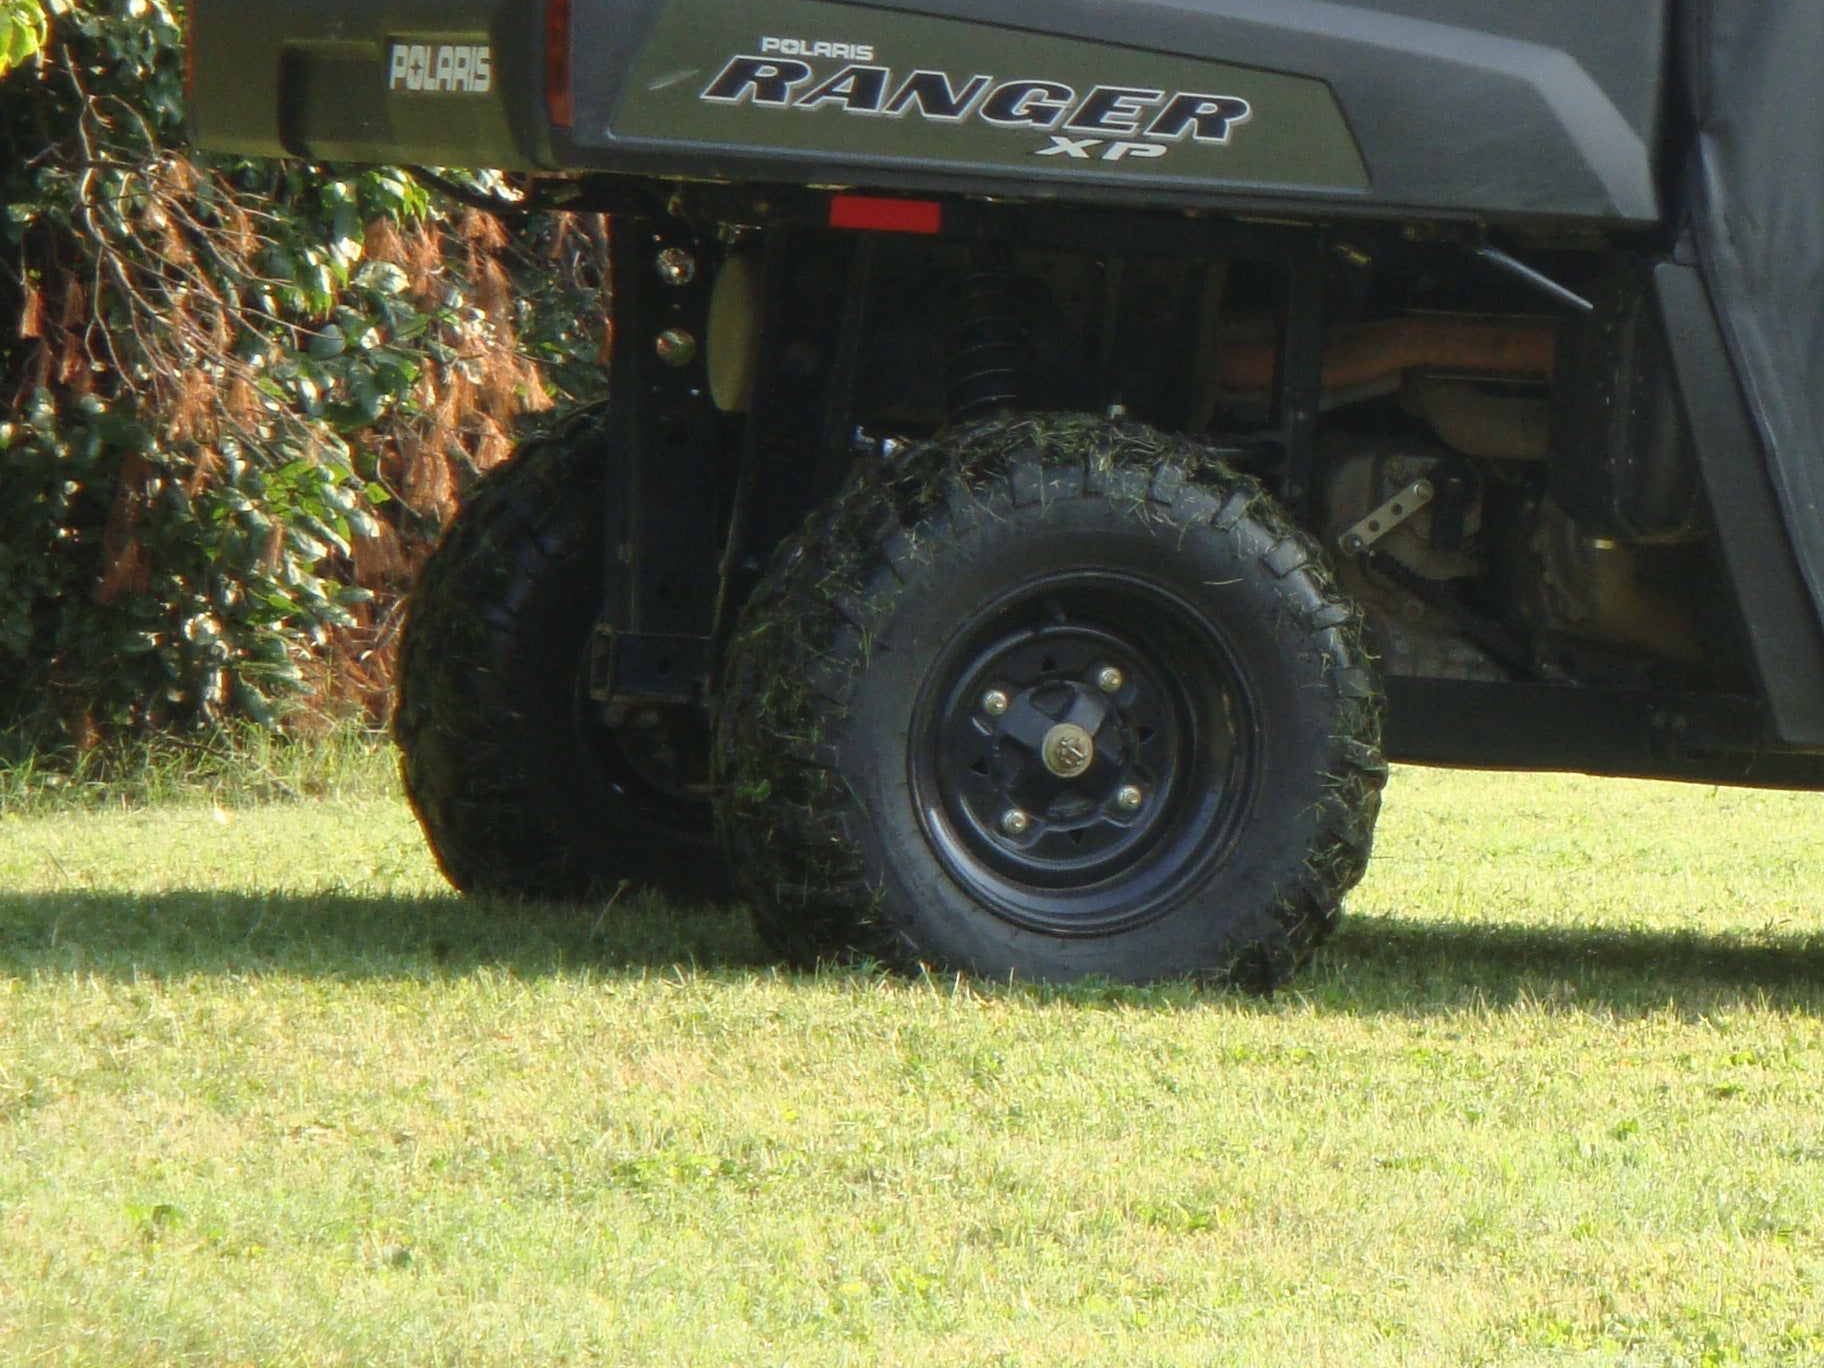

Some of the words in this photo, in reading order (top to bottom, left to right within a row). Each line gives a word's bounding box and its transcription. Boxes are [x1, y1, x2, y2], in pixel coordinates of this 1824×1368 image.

[761, 36, 874, 61] POLARIS
[390, 45, 491, 92] POLARIS
[700, 55, 1252, 143] RANGER
[1034, 135, 1168, 161] XP
